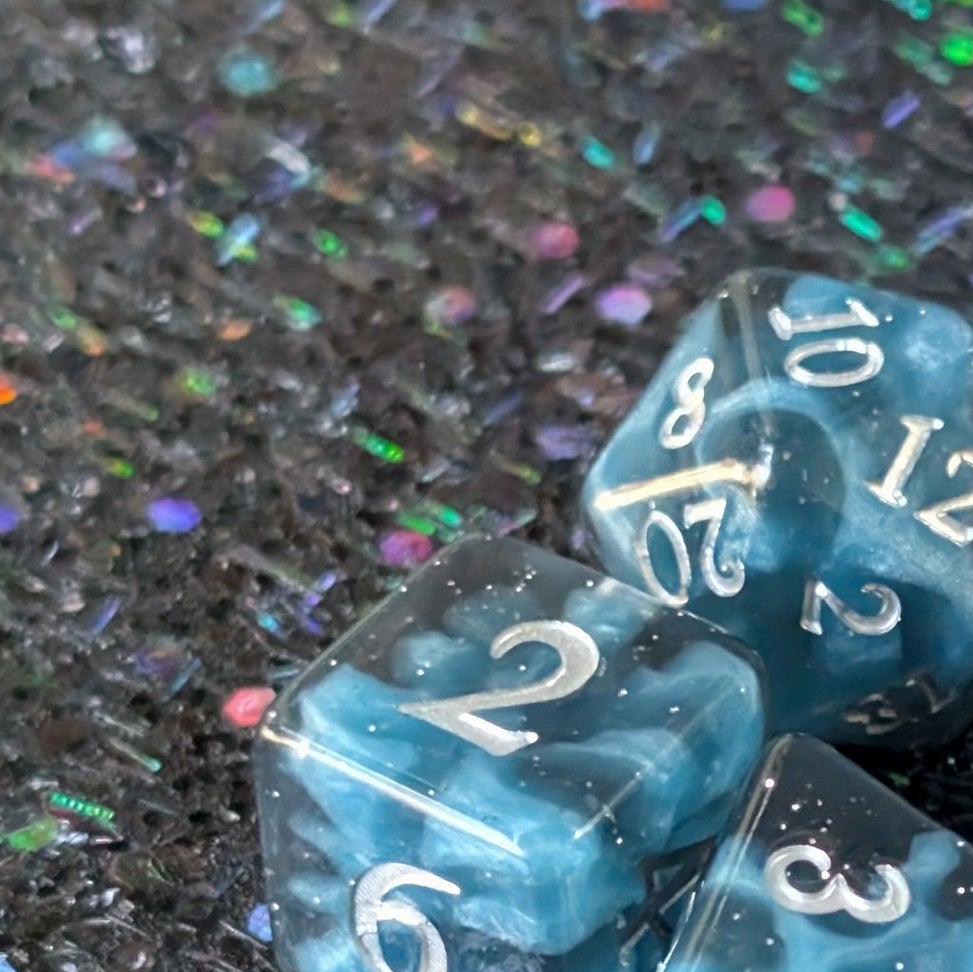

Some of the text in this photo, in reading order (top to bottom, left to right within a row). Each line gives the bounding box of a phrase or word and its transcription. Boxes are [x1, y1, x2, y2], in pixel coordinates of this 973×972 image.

[769, 298, 884, 388] 10
[658, 357, 715, 449] 8
[635, 498, 745, 608] 20
[800, 580, 901, 635] 2
[399, 620, 600, 756] 2
[765, 844, 910, 924] 3
